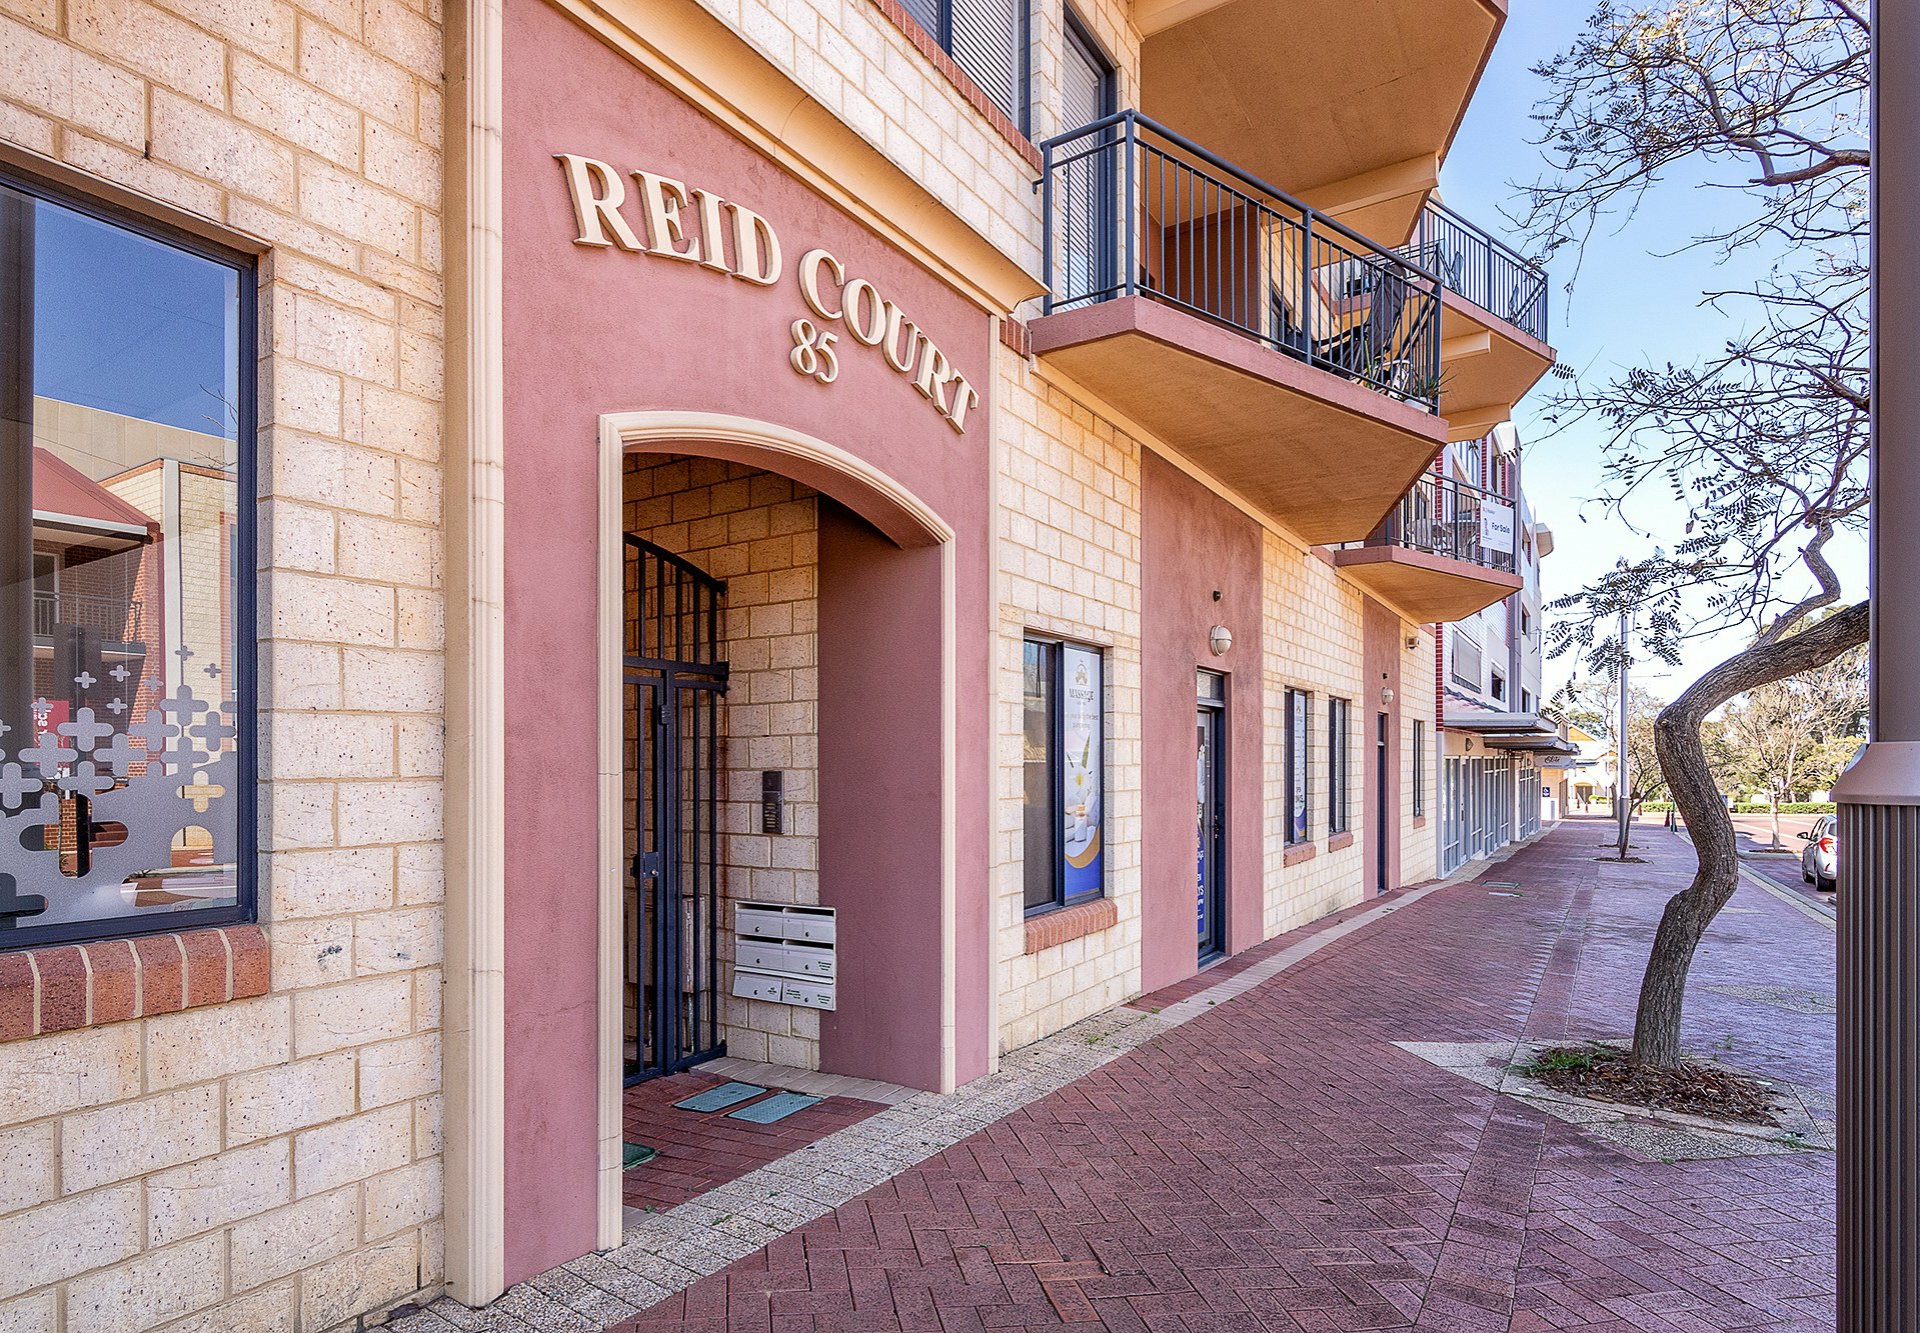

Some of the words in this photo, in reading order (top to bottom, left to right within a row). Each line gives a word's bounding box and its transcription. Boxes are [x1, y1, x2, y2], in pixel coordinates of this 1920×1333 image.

[551, 153, 783, 286] REID
[799, 248, 980, 435] COURT
[790, 317, 840, 384] 85
[1491, 521, 1500, 531] For
[1500, 524, 1511, 534] Sale
